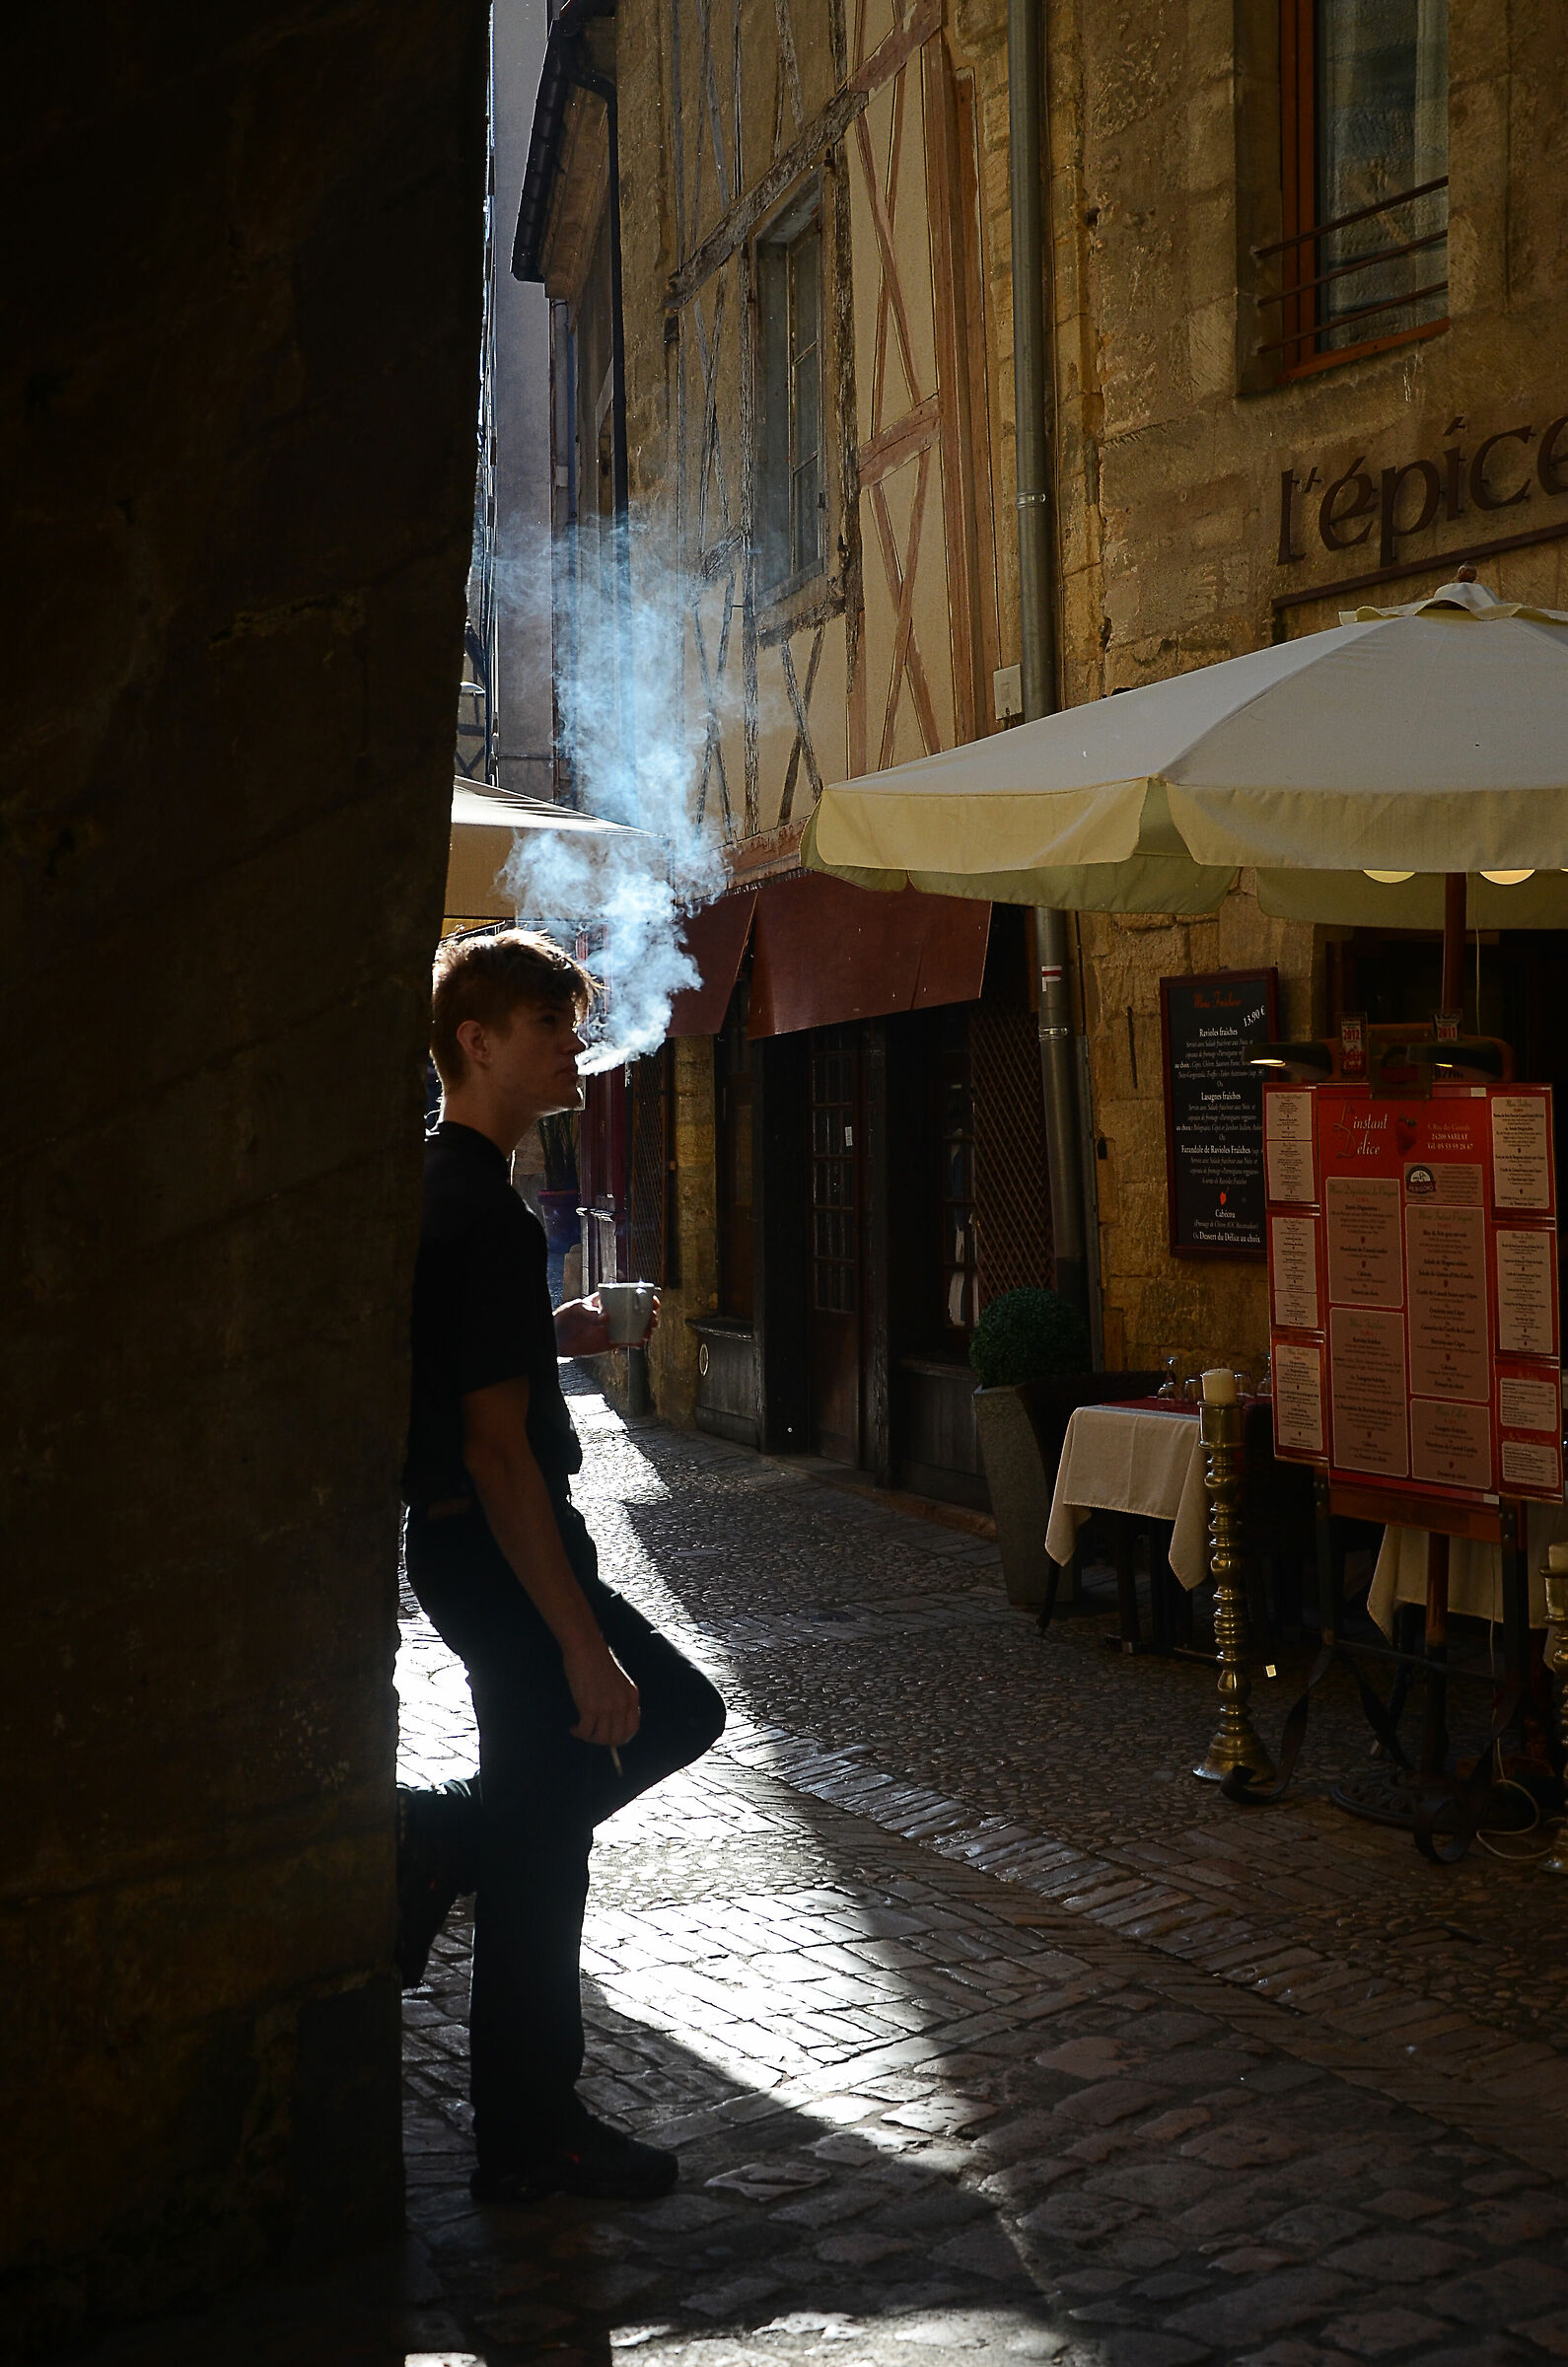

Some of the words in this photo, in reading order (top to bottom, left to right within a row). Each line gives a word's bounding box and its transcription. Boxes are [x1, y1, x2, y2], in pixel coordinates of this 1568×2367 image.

[1243, 1009, 1259, 1027] 13,90
[1199, 1028, 1219, 1038] Ravioles
[1343, 1029, 1360, 1040] 2012
[1438, 1026, 1457, 1039] 2011
[1201, 1091, 1222, 1103] Lasagnes
[1180, 1144, 1204, 1154] Farandole
[1210, 1144, 1231, 1154] Ravioles
[1199, 1231, 1217, 1241] Dessert
[1247, 1233, 1261, 1244] choix
